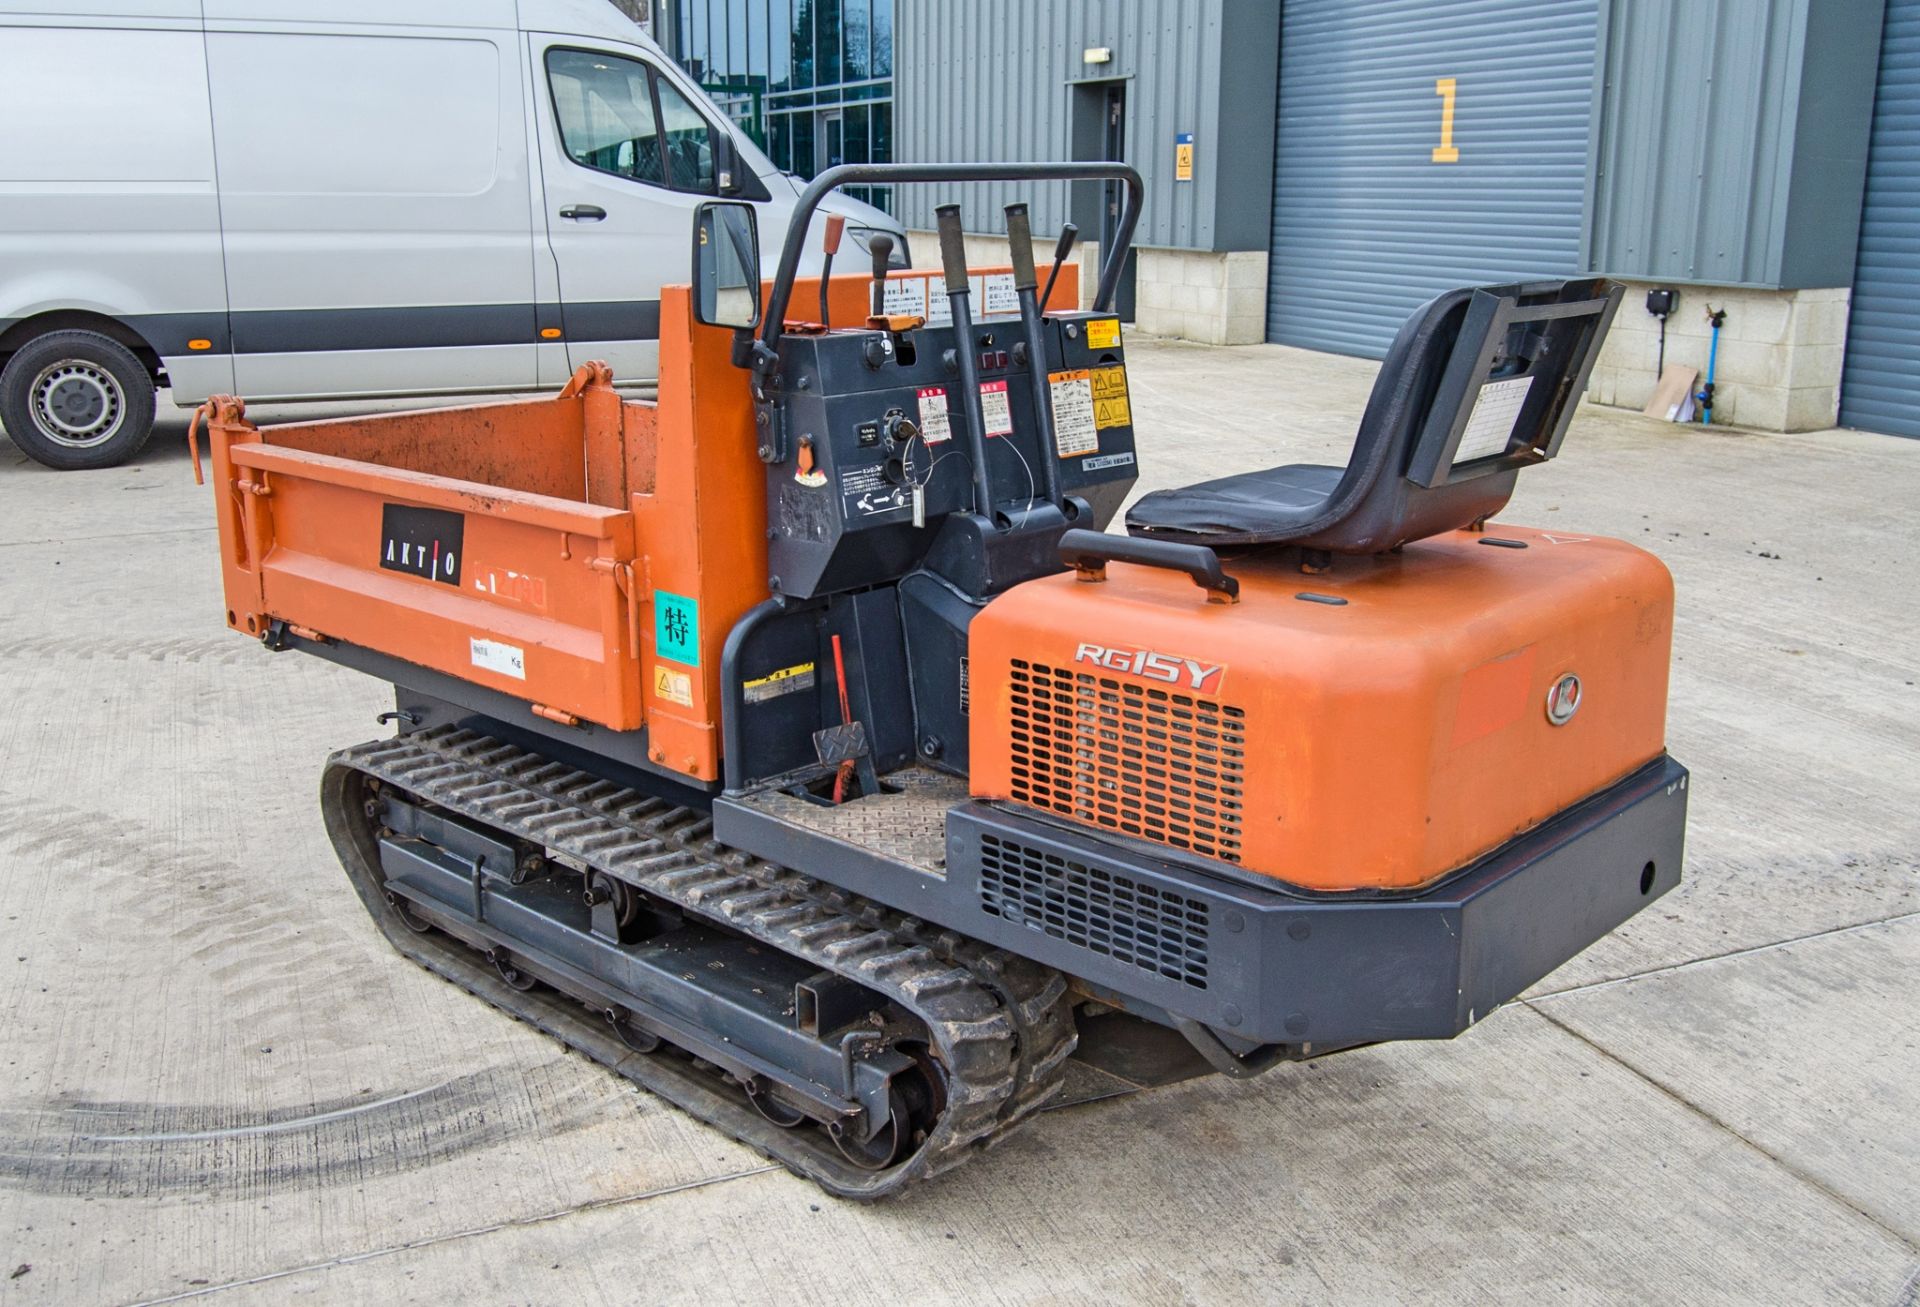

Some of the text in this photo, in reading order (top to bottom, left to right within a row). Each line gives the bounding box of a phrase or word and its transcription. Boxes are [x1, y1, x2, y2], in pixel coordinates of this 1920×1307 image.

[1432, 78, 1459, 163] 1
[386, 539, 455, 581] AKTIO
[664, 606, 689, 647] 特
[1075, 643, 1222, 689] RG15Y
